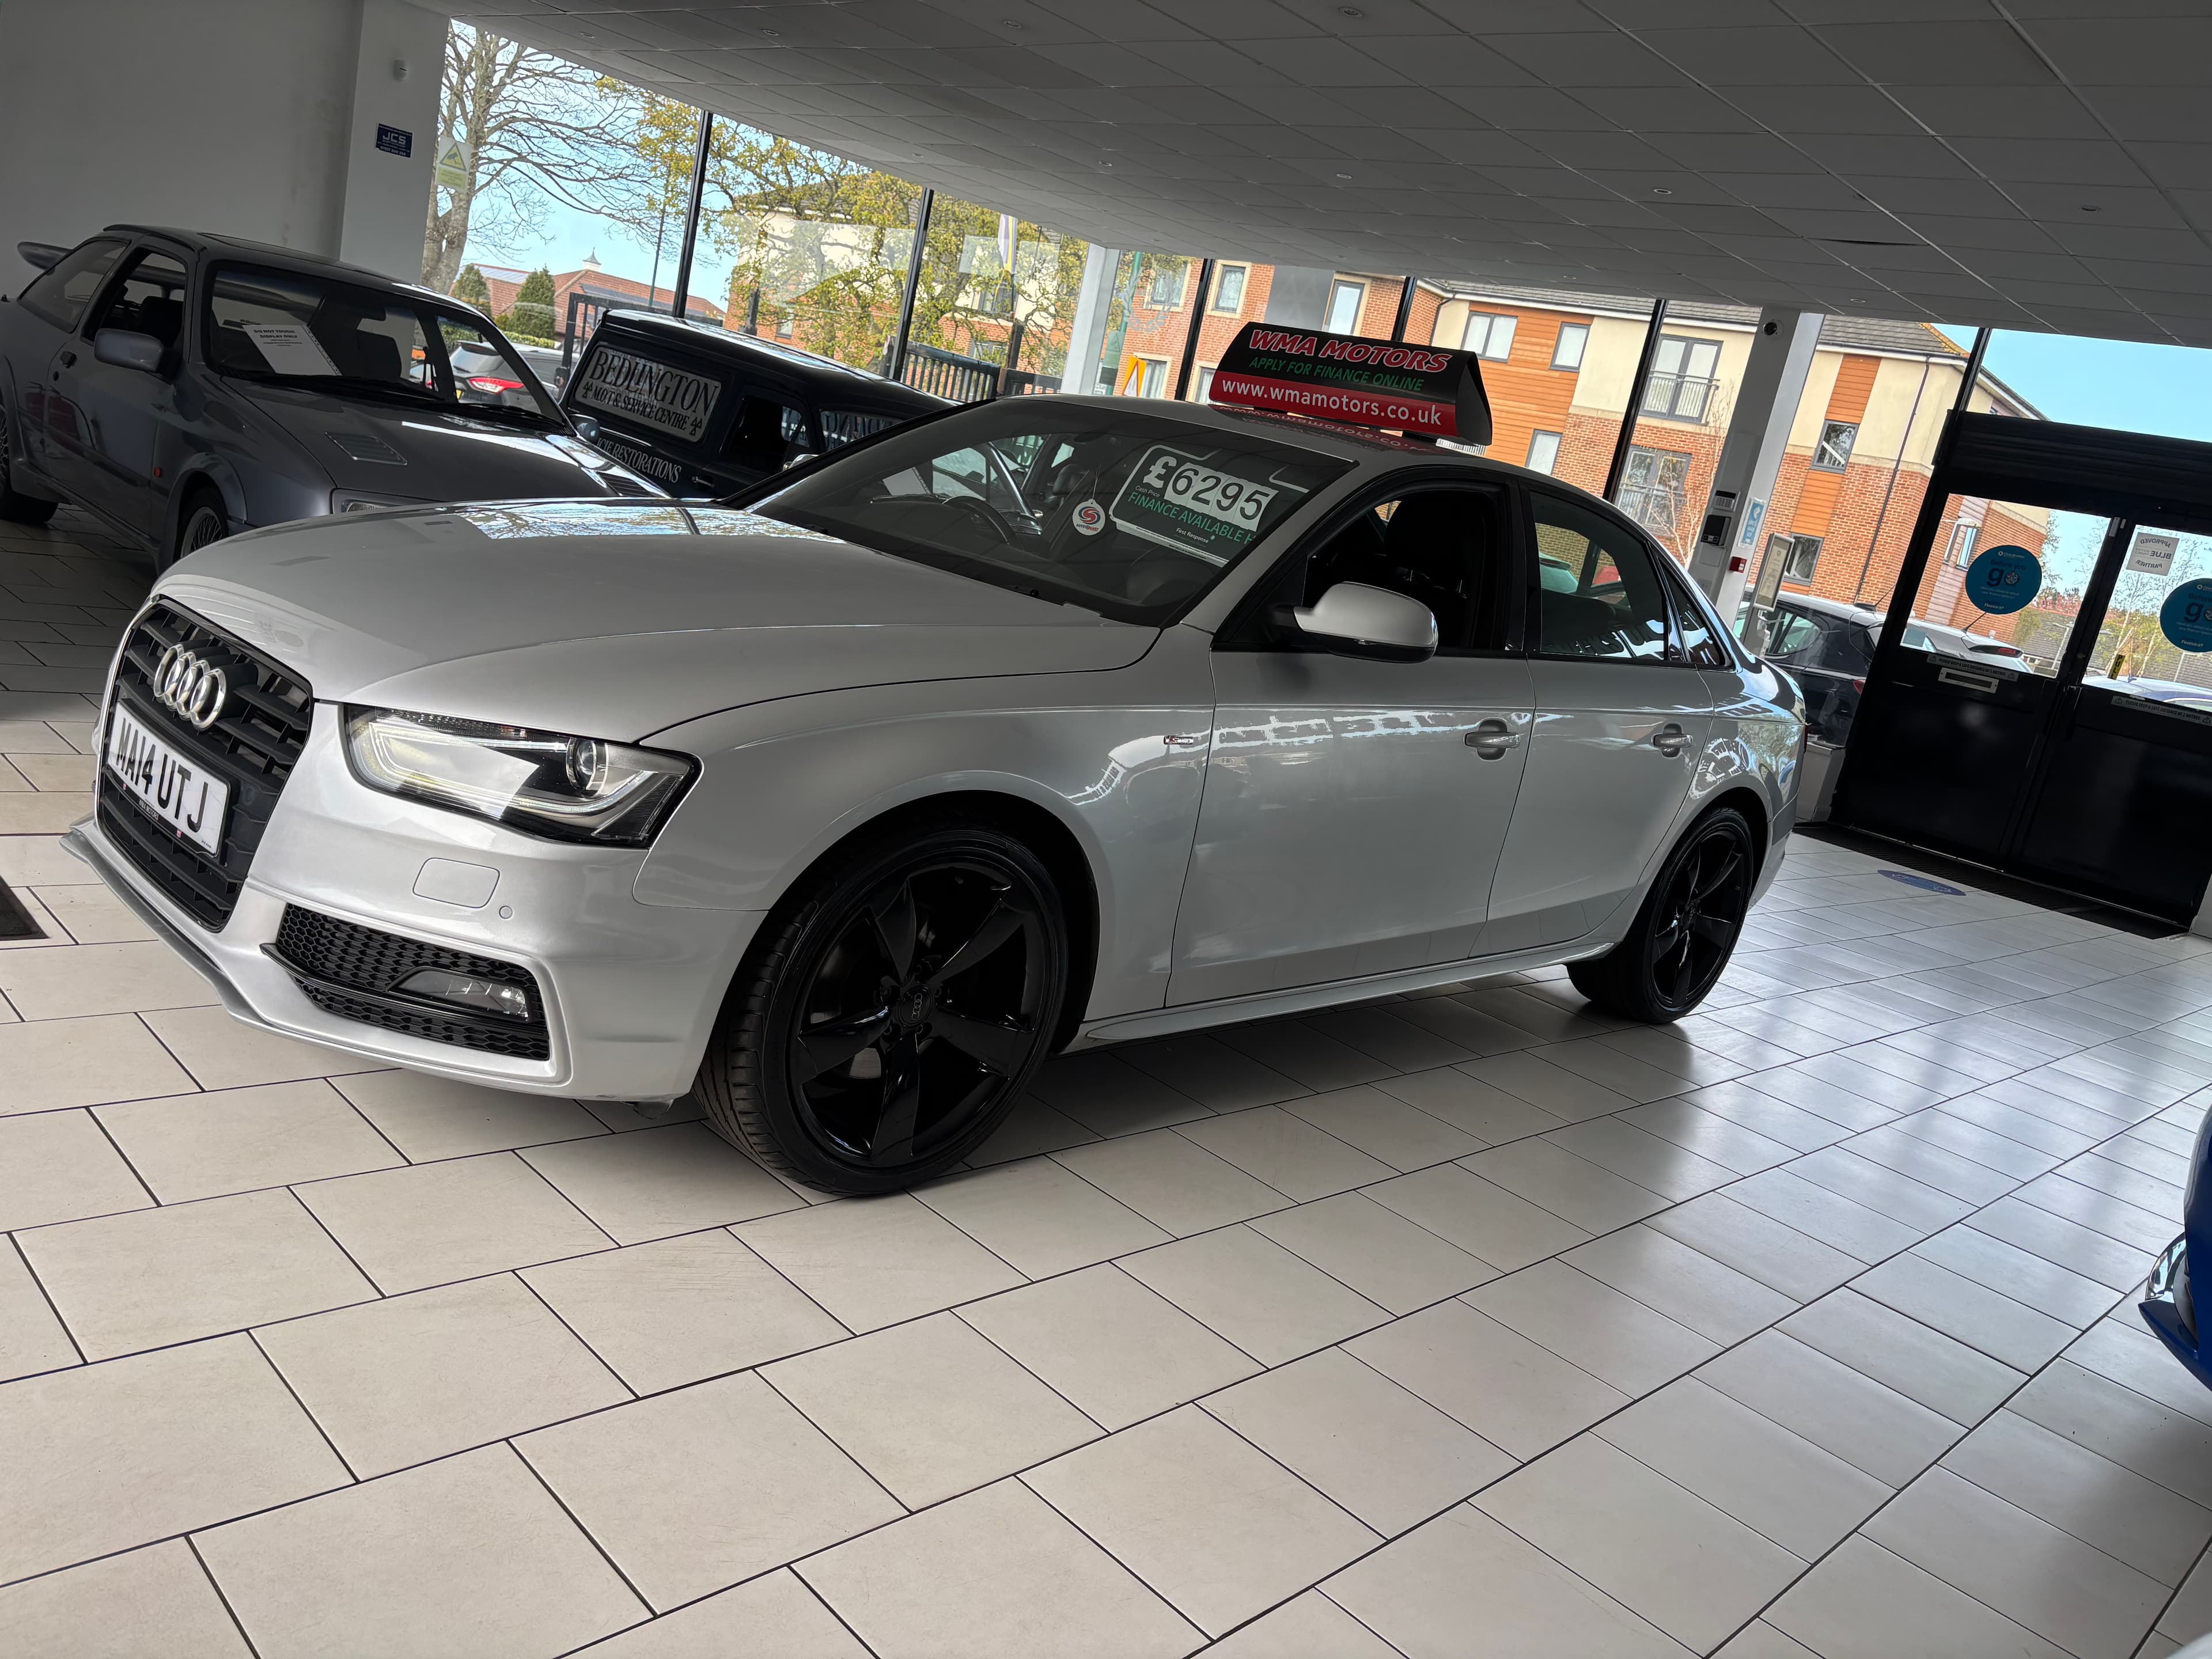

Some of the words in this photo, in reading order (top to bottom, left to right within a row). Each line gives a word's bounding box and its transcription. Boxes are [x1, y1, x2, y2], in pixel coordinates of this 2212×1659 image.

[382, 132, 406, 145] JCS
[1249, 329, 1317, 356] WMA
[1319, 340, 1453, 372] MOTORS
[589, 350, 719, 416] BEDLINGTON
[1249, 356, 1286, 372] APPLY
[1286, 361, 1312, 375] FOR
[1313, 365, 1372, 385] FINANCE
[1372, 373, 1425, 391] ONLINE
[613, 393, 621, 407] &
[620, 395, 657, 419] SERVICE
[654, 407, 690, 431] CENTRE
[1222, 379, 1441, 426] www.wmamotors.co.uk
[612, 444, 682, 483] RESTORATIONS
[1135, 485, 1147, 494] Cash
[1147, 489, 1160, 498] Price
[1142, 456, 1272, 521] £6295
[1128, 491, 1180, 519] FINANCE
[1178, 510, 1245, 542] AVAILABLE
[1176, 527, 1187, 535] First
[1187, 531, 1209, 544] Response
[2111, 654, 2123, 679] PULL
[116, 717, 156, 795] MA14
[157, 753, 209, 833] UTJ
